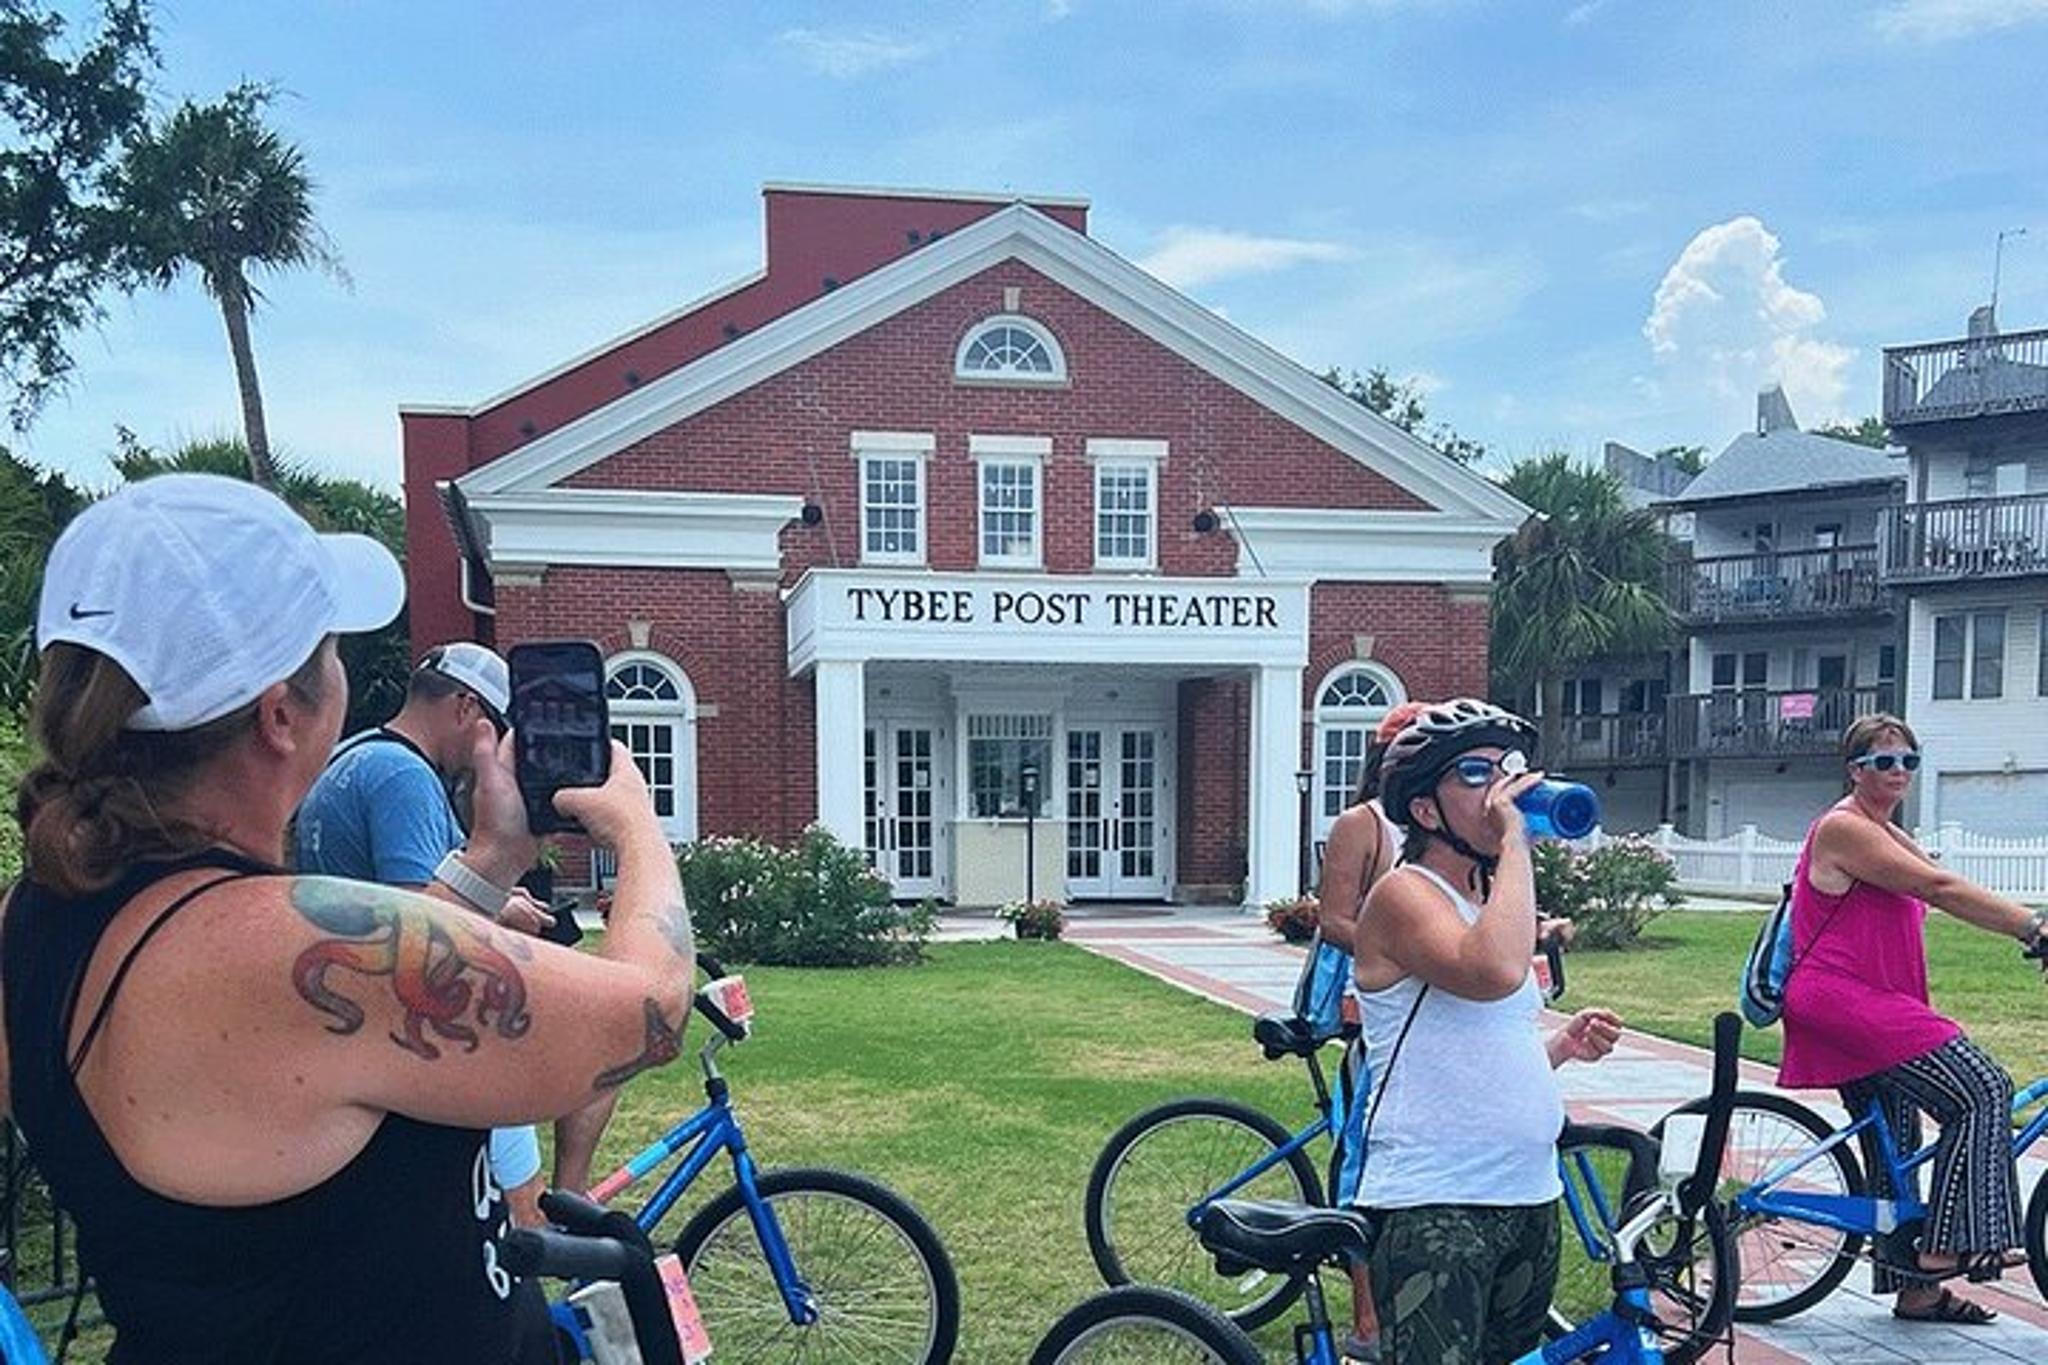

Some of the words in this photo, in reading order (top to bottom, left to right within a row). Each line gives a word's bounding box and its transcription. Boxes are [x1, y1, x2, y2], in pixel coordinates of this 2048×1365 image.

[847, 588, 973, 622] TYBEE
[993, 591, 1091, 625] POST
[1105, 593, 1278, 627] THEATER
